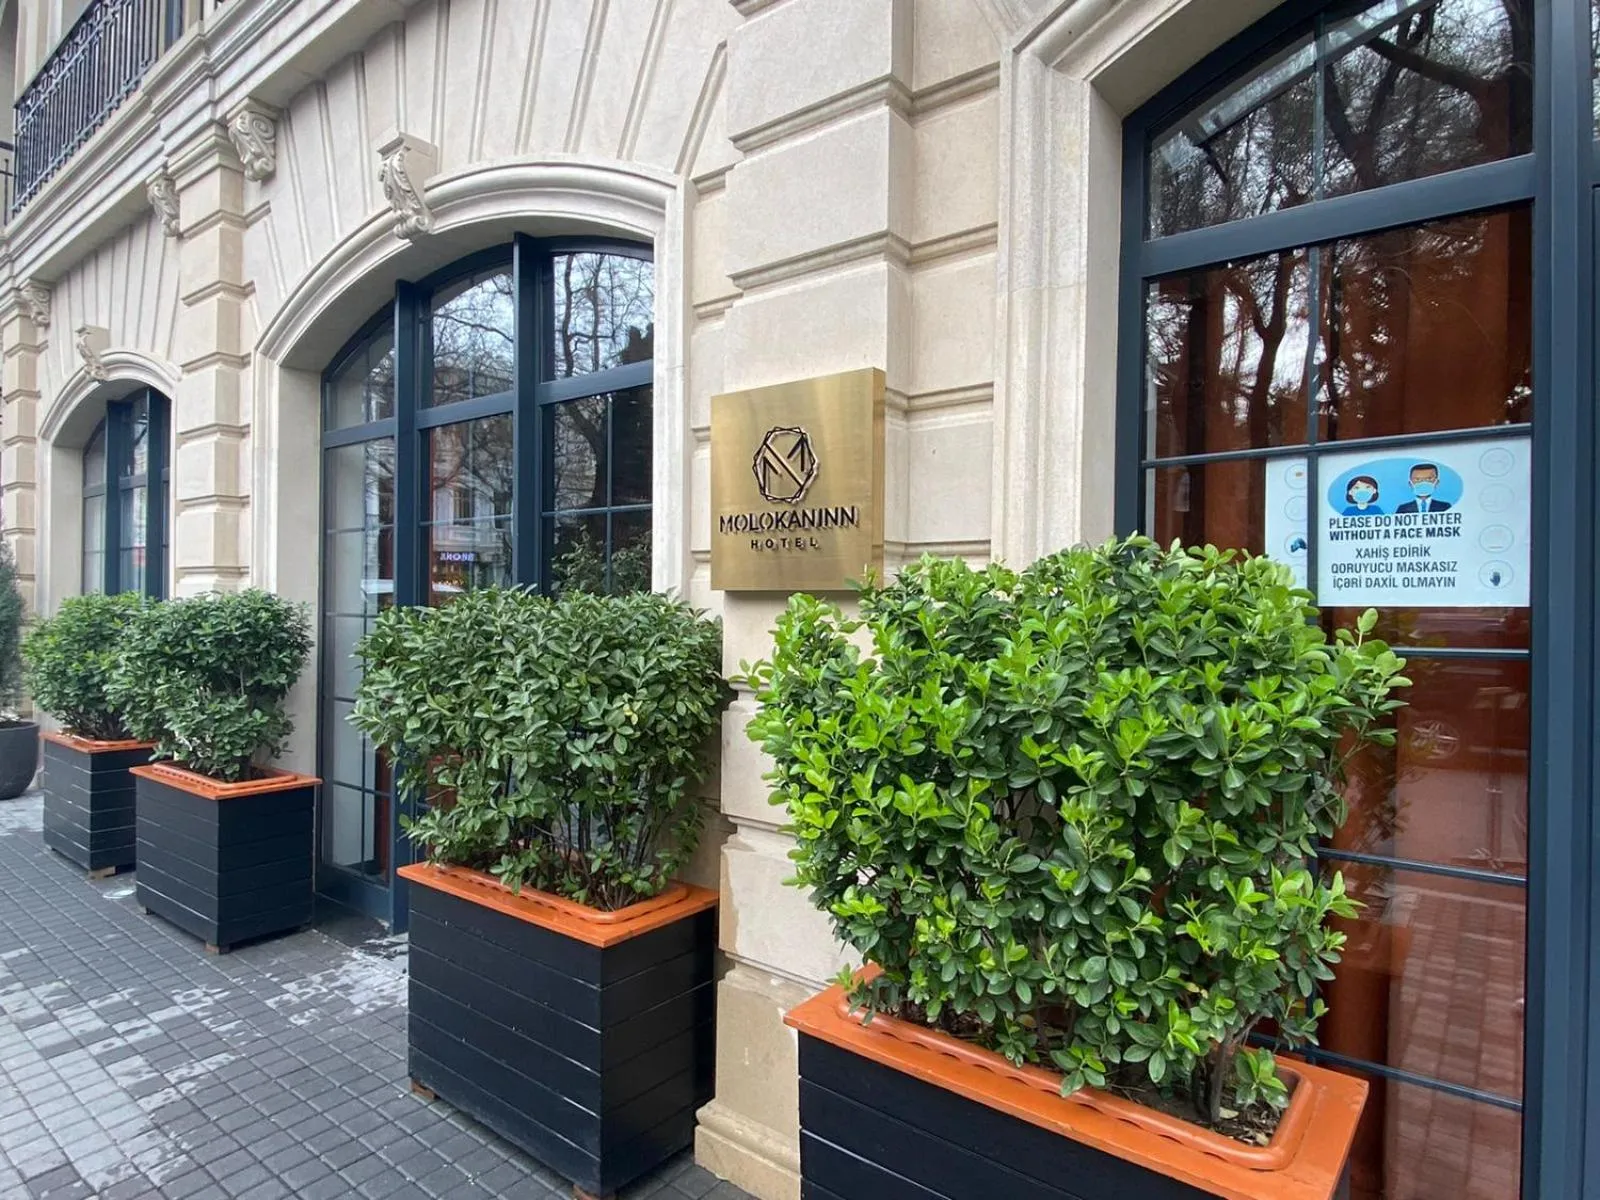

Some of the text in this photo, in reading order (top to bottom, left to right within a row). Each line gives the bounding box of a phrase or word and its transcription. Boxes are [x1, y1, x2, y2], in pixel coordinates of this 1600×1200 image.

[719, 505, 857, 533] MOLOKANINN
[1329, 512, 1462, 529] PLEASE DO NOT ENTER
[1329, 527, 1461, 541] WITHOUT A FACE MASK
[751, 537, 819, 550] HOTEL
[1355, 546, 1431, 560] XAHİŞ EDİRİK
[1331, 561, 1458, 574] QORUYUCU MASKASIZ
[1365, 575, 1400, 588] DAXİL
[1402, 576, 1456, 589] OLMAYIN
